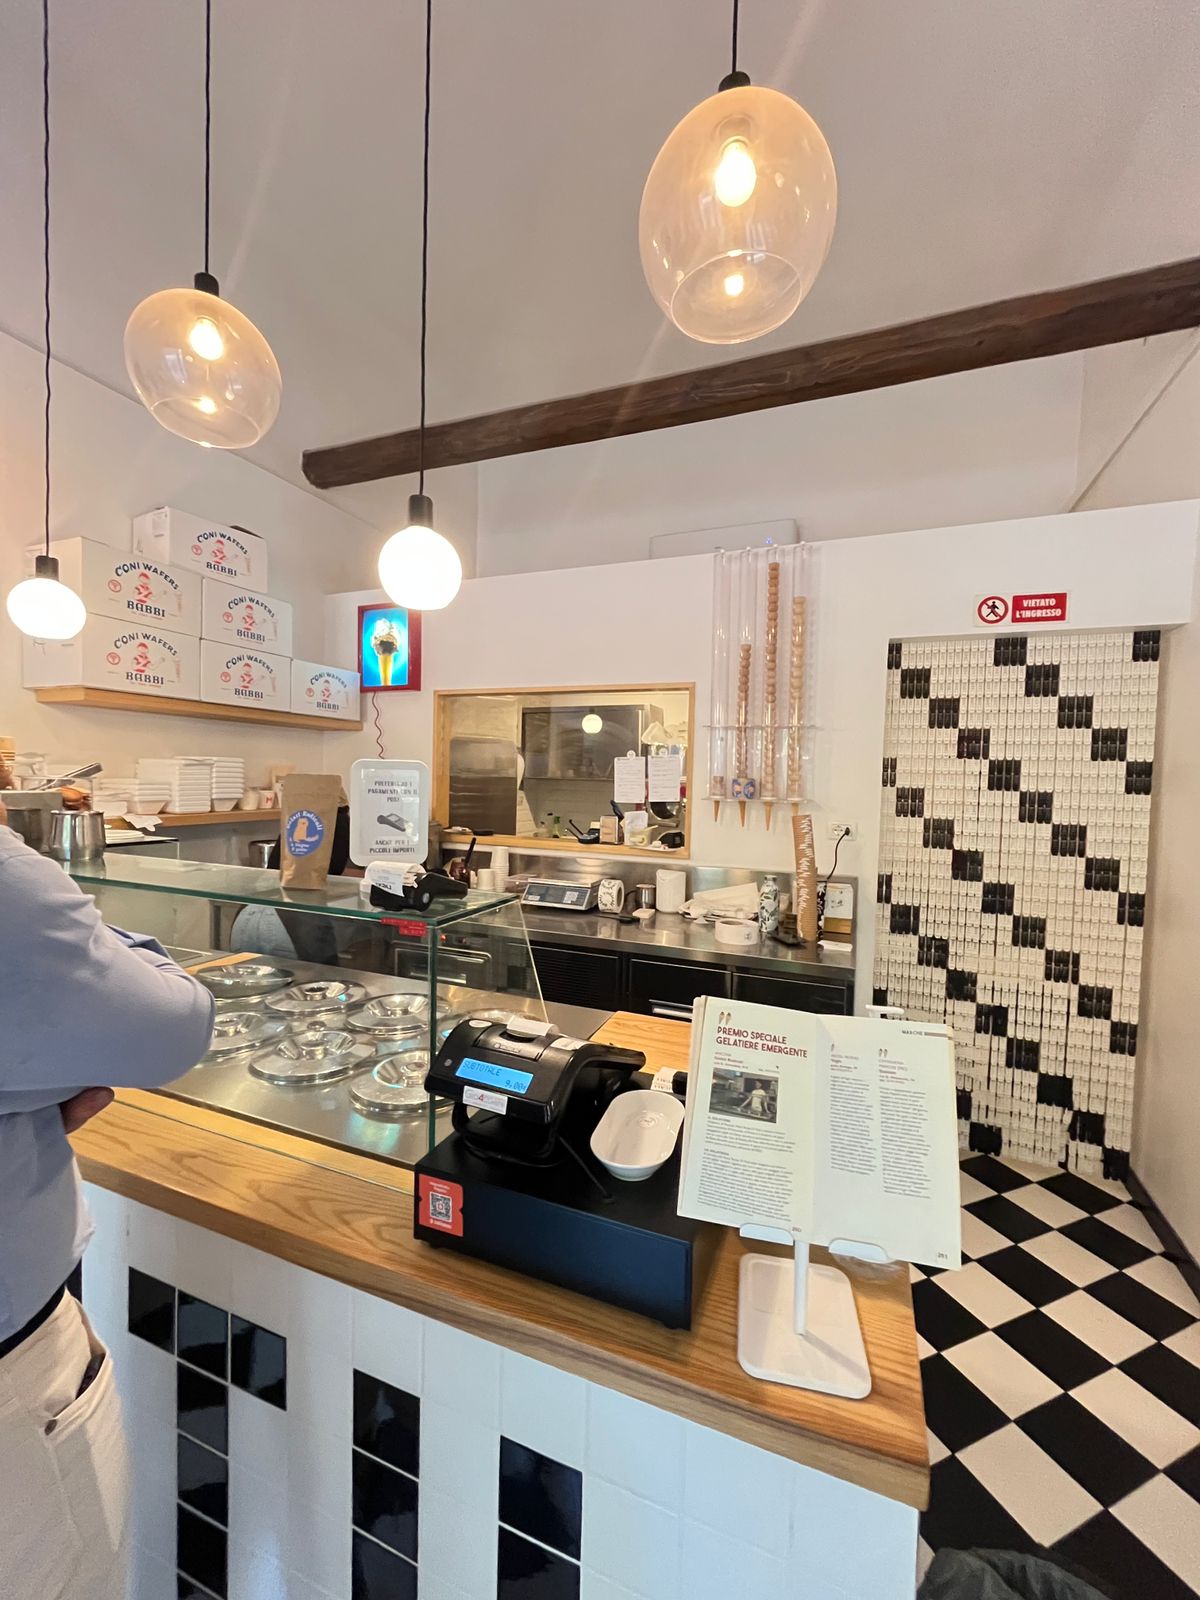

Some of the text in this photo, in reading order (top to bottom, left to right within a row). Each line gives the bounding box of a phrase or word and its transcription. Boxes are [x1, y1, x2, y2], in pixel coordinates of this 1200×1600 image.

[197, 531, 248, 554] CONI WAFERS
[115, 562, 179, 590] CONI WAFERS
[206, 561, 237, 576] BABBI
[127, 600, 165, 617] BABBI
[228, 596, 275, 618] CONI WAFERS
[1023, 598, 1056, 607] VIETATO
[1016, 609, 1062, 618] L'INGRESSO
[114, 632, 178, 656] CONI WAFERS
[237, 629, 265, 642] BABBI
[226, 654, 274, 674] CONI WAFERS
[126, 671, 164, 685] BABBI
[234, 688, 263, 699] BABBI
[316, 701, 340, 710] BABBI
[717, 1026, 787, 1045] PREMIO SPECIALE
[716, 1036, 808, 1059] GELATIERE EMERGENTE
[462, 1060, 502, 1077] SUBTOTALE
